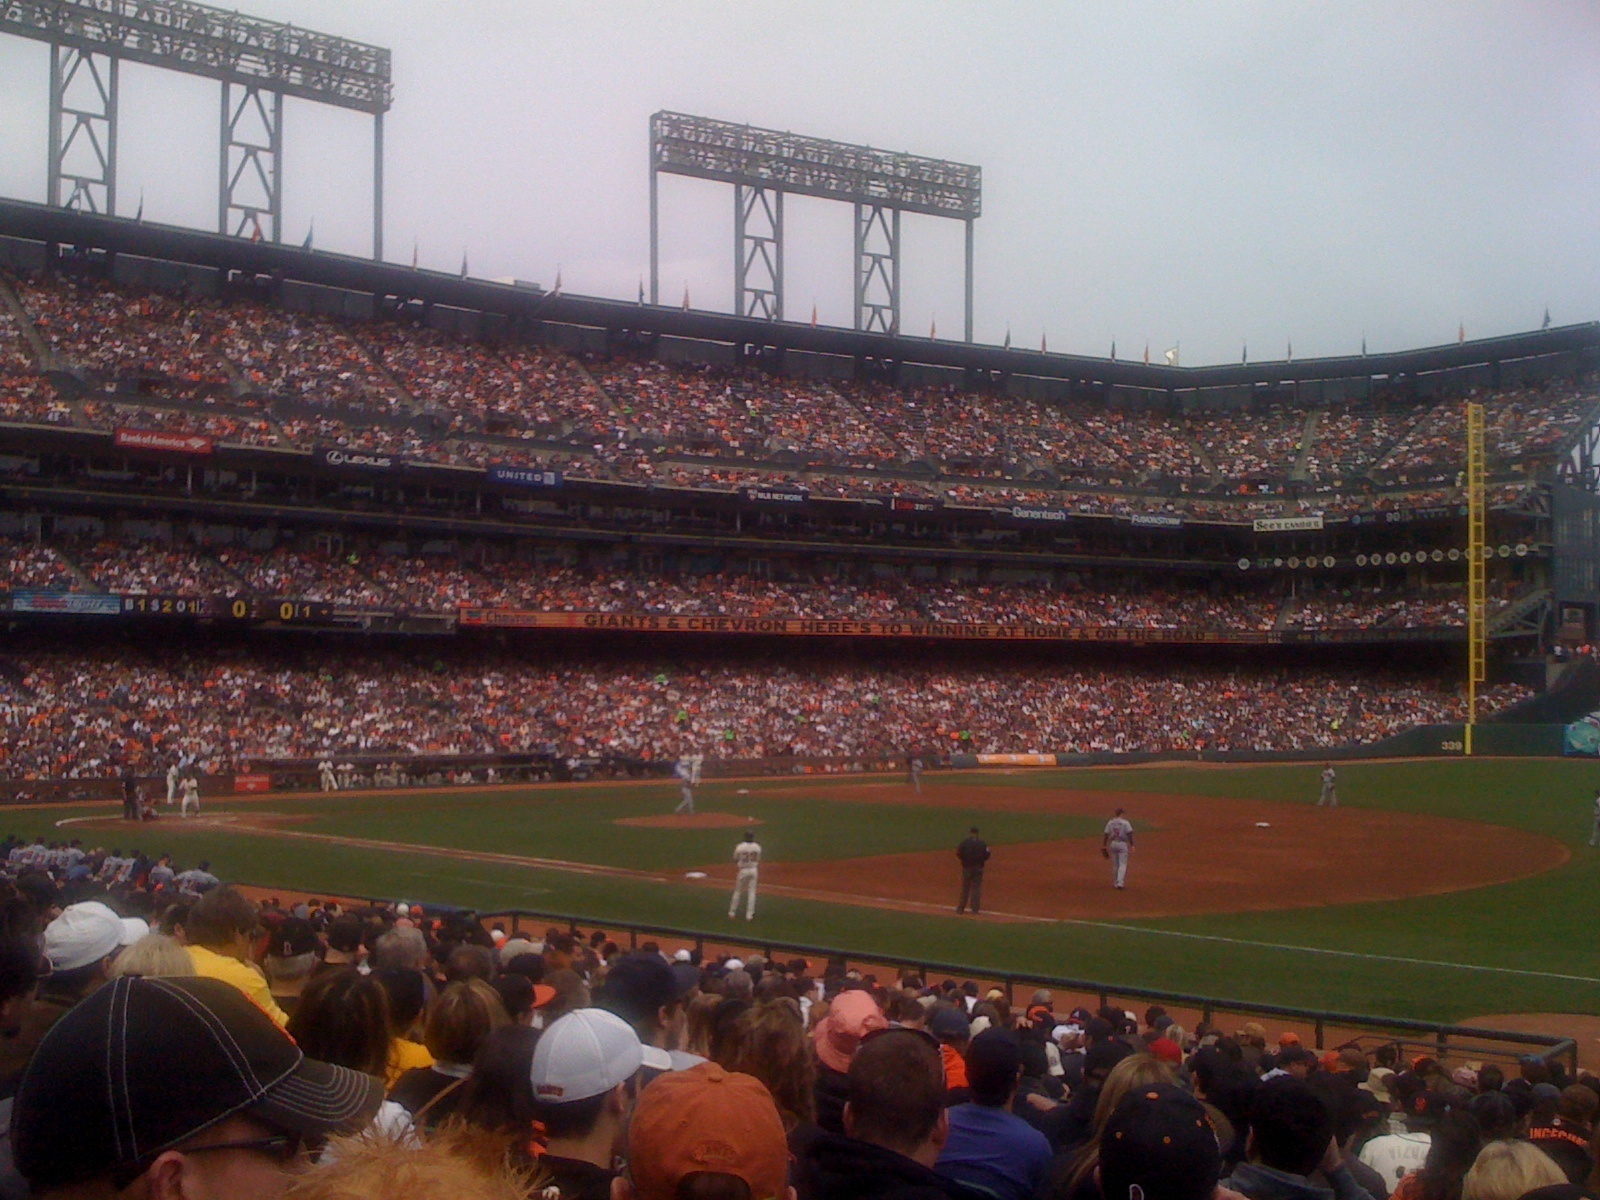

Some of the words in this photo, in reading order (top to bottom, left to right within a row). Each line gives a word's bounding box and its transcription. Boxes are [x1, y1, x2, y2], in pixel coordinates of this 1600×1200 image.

[120, 433, 141, 442] Bank
[142, 434, 151, 444] of
[152, 435, 185, 447] America
[344, 454, 391, 467] LEXUS
[497, 470, 542, 482] UNITED
[757, 492, 771, 500] MLB
[772, 493, 803, 501] NETWORK
[1012, 506, 1066, 520] Genentech
[1256, 520, 1281, 530] See's
[162, 600, 172, 613] 2
[232, 600, 246, 618] 0
[280, 602, 294, 620] 0
[584, 615, 659, 629] GIANTS
[687, 618, 786, 632] CHEVRON
[800, 620, 871, 634] HERE'S
[881, 623, 902, 634] TO
[910, 624, 989, 637] WINNING
[996, 626, 1015, 637] AT
[1024, 626, 1071, 639] HOME
[1096, 629, 1117, 640] ON
[1127, 629, 1152, 640] THE
[1162, 630, 1205, 640] ROAD
[1441, 741, 1463, 751] 339
[1529, 1127, 1588, 1147] INCECUM
